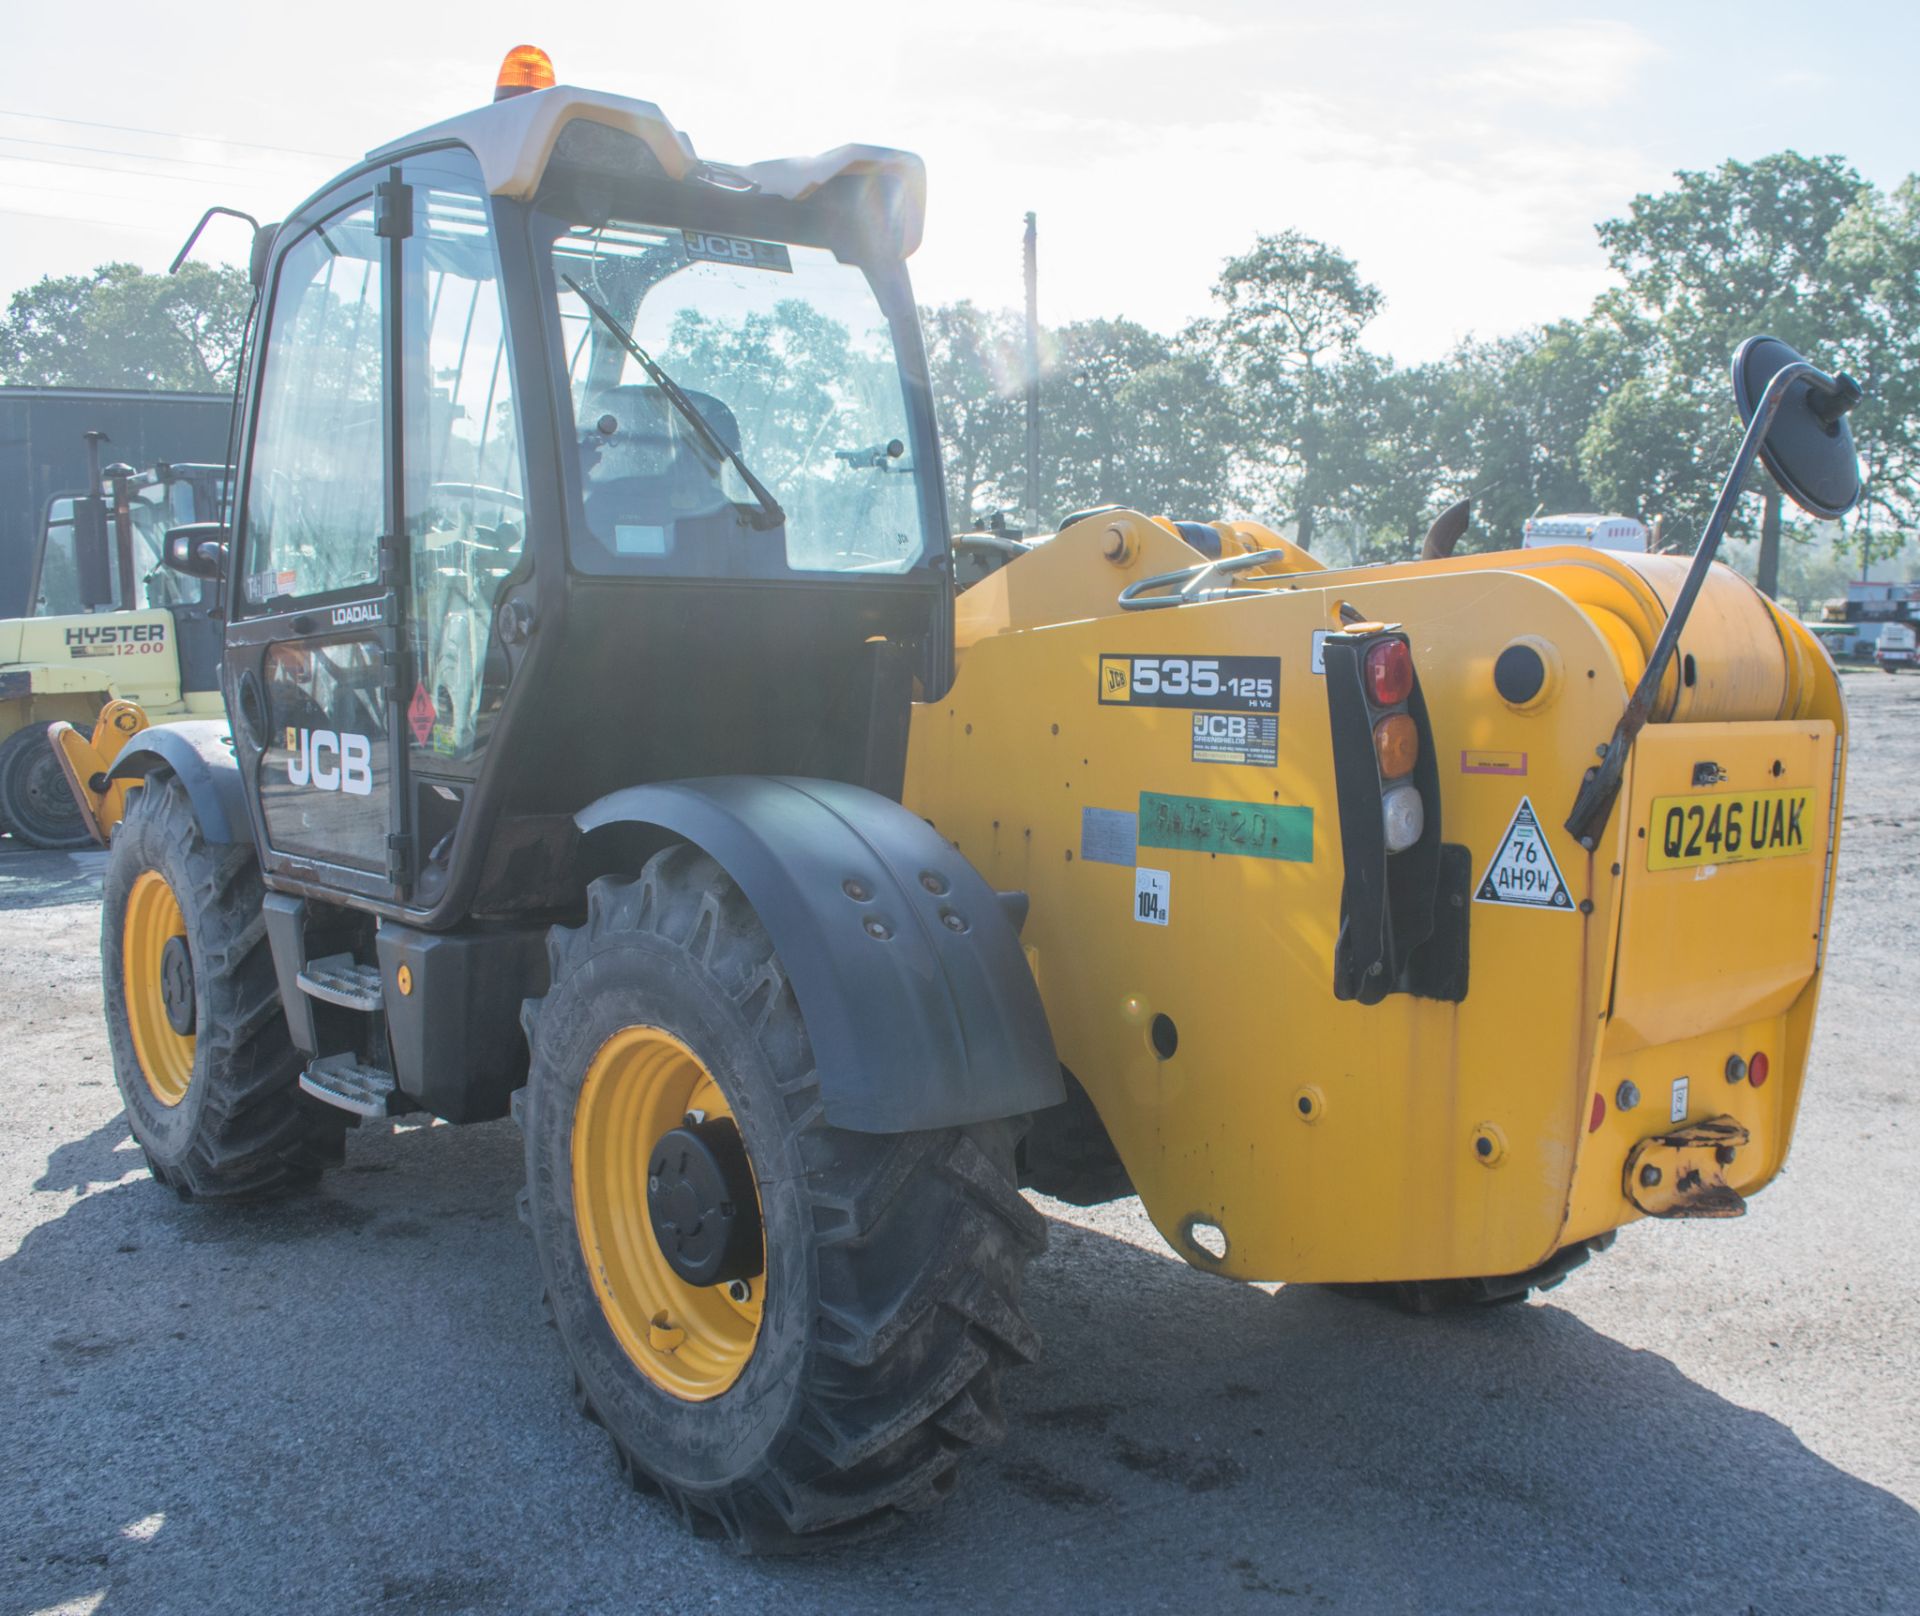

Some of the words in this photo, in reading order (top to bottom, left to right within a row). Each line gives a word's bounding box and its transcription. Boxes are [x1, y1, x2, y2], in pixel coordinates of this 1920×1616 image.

[686, 234, 755, 260] JCB
[332, 604, 382, 625] LOADALL
[65, 624, 164, 645] HYSTER
[116, 642, 164, 656] 12.00
[1109, 668, 1126, 690] JCB
[1248, 699, 1258, 708] Hi
[1259, 700, 1272, 709] Viz
[1194, 715, 1247, 738] JCB
[287, 727, 373, 796] JCB
[1663, 802, 1743, 858] Q246
[1751, 798, 1806, 850] UAK
[1513, 840, 1538, 864] 76
[1152, 878, 1158, 888] L
[1498, 867, 1550, 893] AH9W
[1138, 891, 1158, 919] 104
